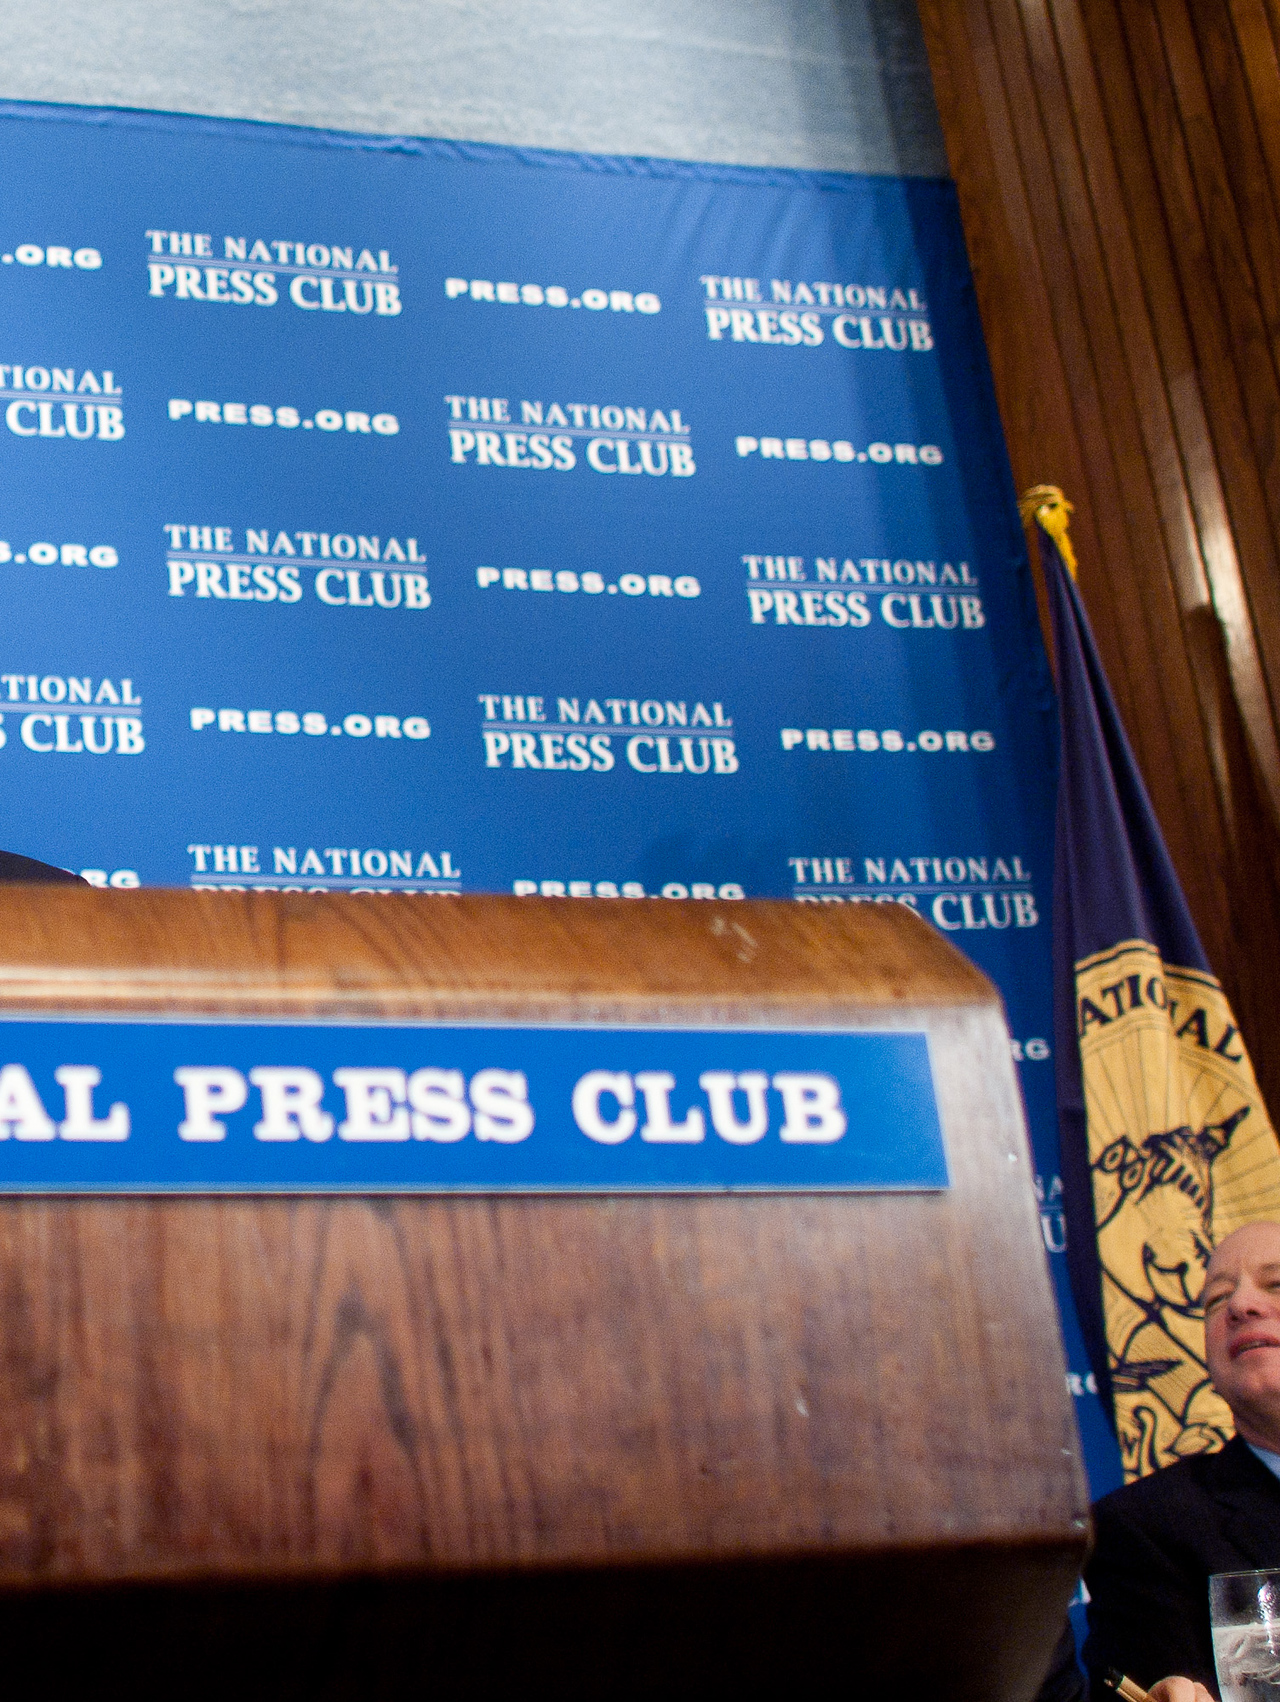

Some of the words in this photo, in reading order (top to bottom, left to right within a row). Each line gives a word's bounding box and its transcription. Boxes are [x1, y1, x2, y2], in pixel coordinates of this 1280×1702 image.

[146, 230, 212, 256] THE
[225, 237, 397, 273] NATIONAL
[148, 263, 278, 304] PRESS
[290, 276, 402, 315] CLUB
[446, 278, 661, 313] PRESS.ORG
[701, 276, 759, 301] THE
[771, 279, 925, 308] NATIONAL
[706, 307, 823, 345] PRESS
[833, 318, 933, 349] CLUB
[6, 401, 125, 439] CLUB
[169, 399, 399, 434] PRESS.ORG
[445, 396, 510, 421] THE
[522, 401, 689, 433] NATIONAL
[450, 430, 576, 470] PRESS
[588, 439, 696, 476] CLUB
[736, 436, 942, 463] PRESS.ORG
[164, 525, 233, 551] THE
[246, 530, 426, 562] NATIONAL
[167, 561, 302, 602] PRESS
[316, 569, 431, 608] CLUB
[477, 567, 701, 597] PRESS.ORG
[743, 555, 805, 581] THE
[816, 558, 977, 585] NATIONAL
[748, 589, 871, 626] PRESS
[881, 593, 985, 627] CLUB
[191, 708, 431, 739] PRESS.ORG
[479, 695, 547, 723] THE
[558, 698, 731, 726] NATIONAL
[21, 714, 145, 754] CLUB
[781, 729, 994, 751] PRESS.ORG
[483, 732, 614, 771] PRESS
[627, 736, 739, 773] CLUB
[188, 846, 260, 872] THE
[273, 848, 460, 878] NATIONAL
[790, 859, 855, 882] THE
[865, 858, 1030, 881] NATIONAL
[514, 880, 745, 901] PRESS.ORG
[933, 894, 1038, 930] CLUB
[176, 1067, 534, 1143] PRESS
[572, 1072, 846, 1144] CLUB
